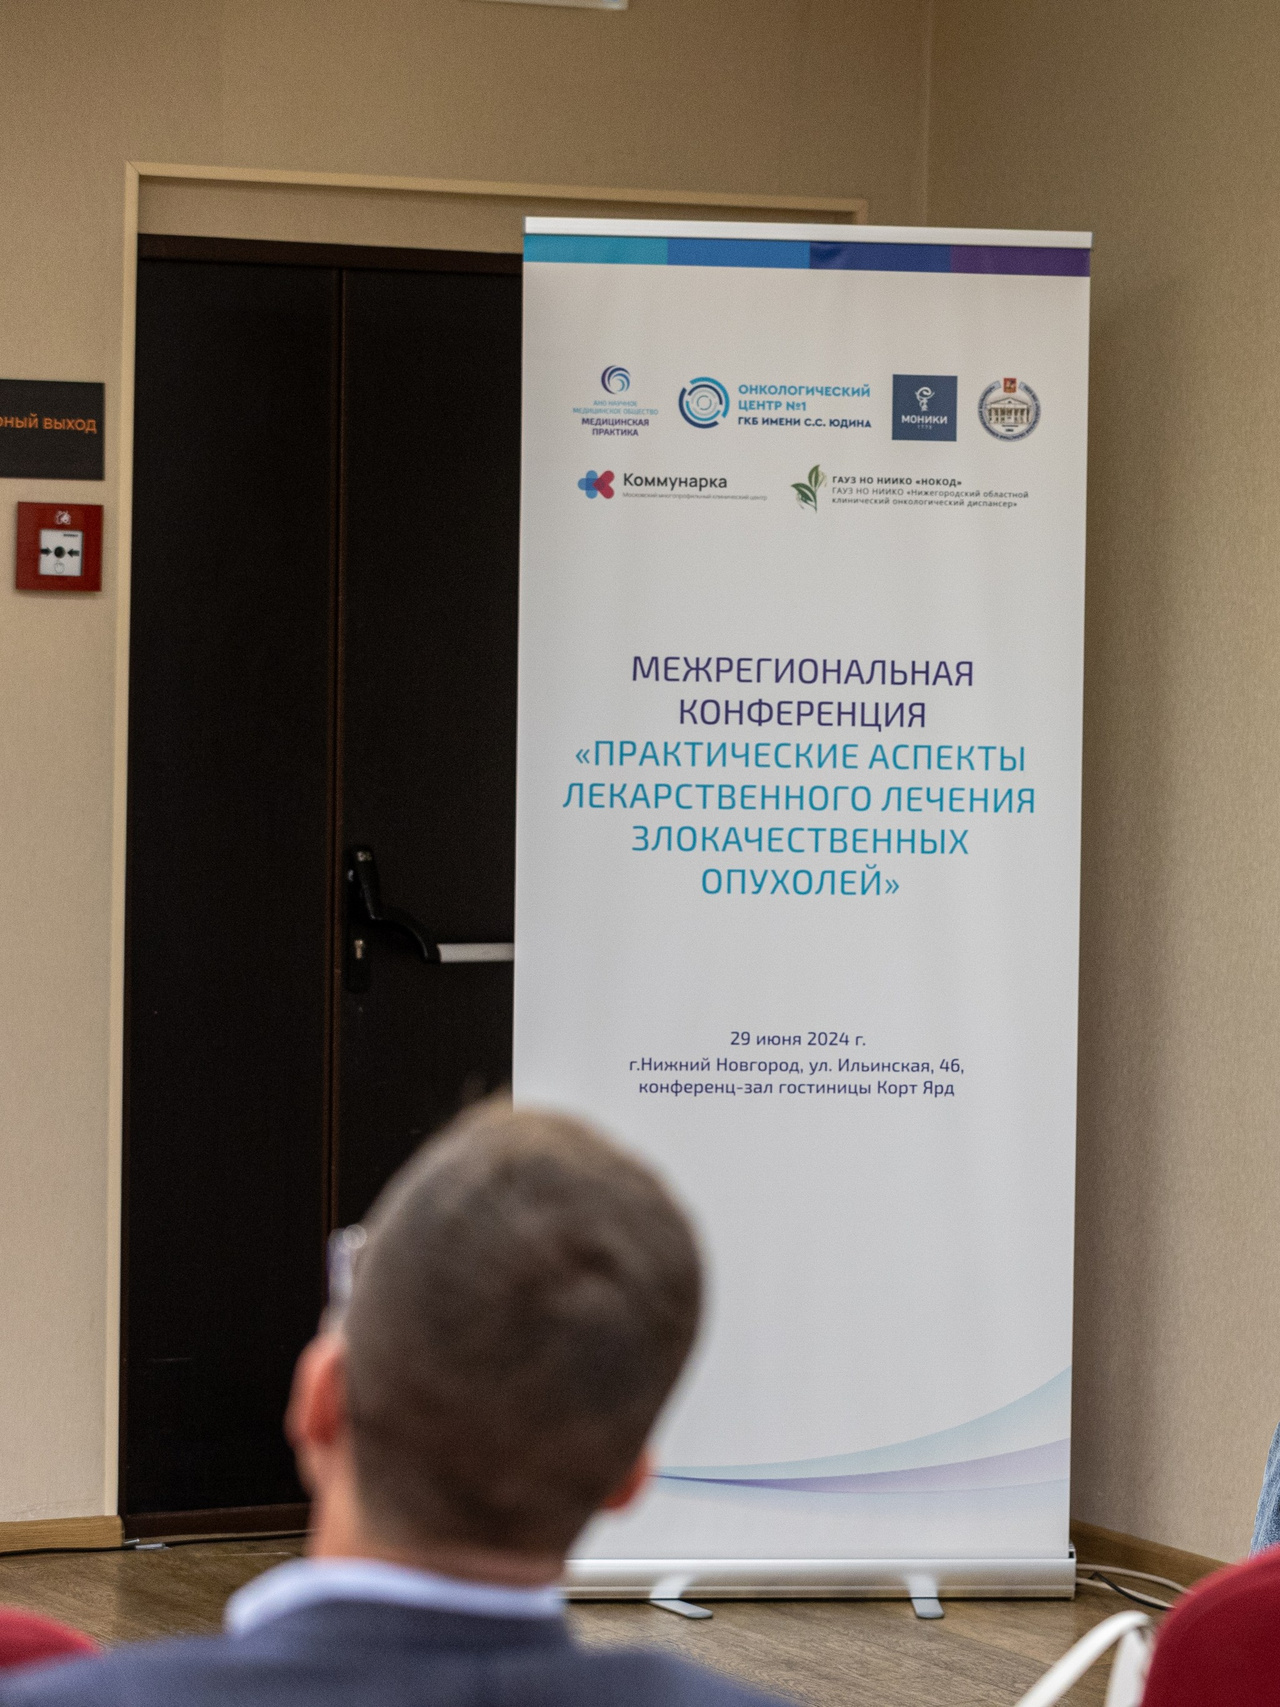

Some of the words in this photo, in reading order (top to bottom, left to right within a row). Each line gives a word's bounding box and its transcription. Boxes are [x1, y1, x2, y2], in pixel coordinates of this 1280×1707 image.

[738, 384, 870, 397] ОНКОЛОГИЧЕСКИЙ
[739, 400, 782, 411] ЦЕНТР
[786, 402, 806, 410] №1
[581, 418, 649, 427] МЕДИЦИНСКАЯ
[738, 417, 758, 425] ГКБ
[762, 418, 800, 426] ИМЕНИ
[804, 418, 826, 427] С.С.
[829, 419, 871, 428] ЮДИНА
[902, 415, 947, 424] МОНИКИ
[592, 428, 639, 436] ПРАКТИКА
[623, 472, 728, 492] Коммунарка
[831, 475, 857, 485] ГАУЗ
[859, 476, 874, 485] НО
[876, 477, 913, 486] НИИКО
[915, 477, 963, 488] «НОКОД»
[831, 486, 854, 495] ГАУЗ
[855, 487, 870, 495] НО
[872, 488, 904, 496] НИИКО
[906, 489, 981, 498] «Нижегородский
[982, 489, 1029, 499] областной
[831, 497, 890, 505] клинический
[891, 498, 965, 506] онкологический
[966, 500, 1018, 510] диспансер»
[631, 655, 974, 687] МЕЖРЕГИОНАЛЬНАЯ
[679, 698, 926, 733] КОНФЕРЕНЦИЯ
[575, 740, 859, 770] «ПРАКТИЧЕСКИЕ
[868, 743, 1025, 772] АСПЕКТЫ
[562, 782, 872, 812] ЛЕКАРСТВЕННОГО
[880, 786, 1035, 814] ЛЕЧЕНИЯ
[631, 824, 969, 855] ЗЛОКАЧЕСТВЕННЫХ
[701, 863, 900, 896] ОПУХОЛЕЙ»
[730, 1030, 751, 1046] 29
[756, 1034, 802, 1046] июня
[807, 1031, 850, 1047] 2024
[854, 1035, 867, 1047] г.
[629, 1057, 711, 1072] г.Нижний
[716, 1057, 804, 1076] Новгород,
[808, 1061, 833, 1076] ул.
[837, 1057, 935, 1075] Ильинская,
[939, 1057, 965, 1075] 46,
[638, 1079, 774, 1098] конференц-зал
[778, 1083, 872, 1097] гостиницы
[876, 1080, 918, 1098] Корт
[922, 1079, 956, 1099] Ярд
